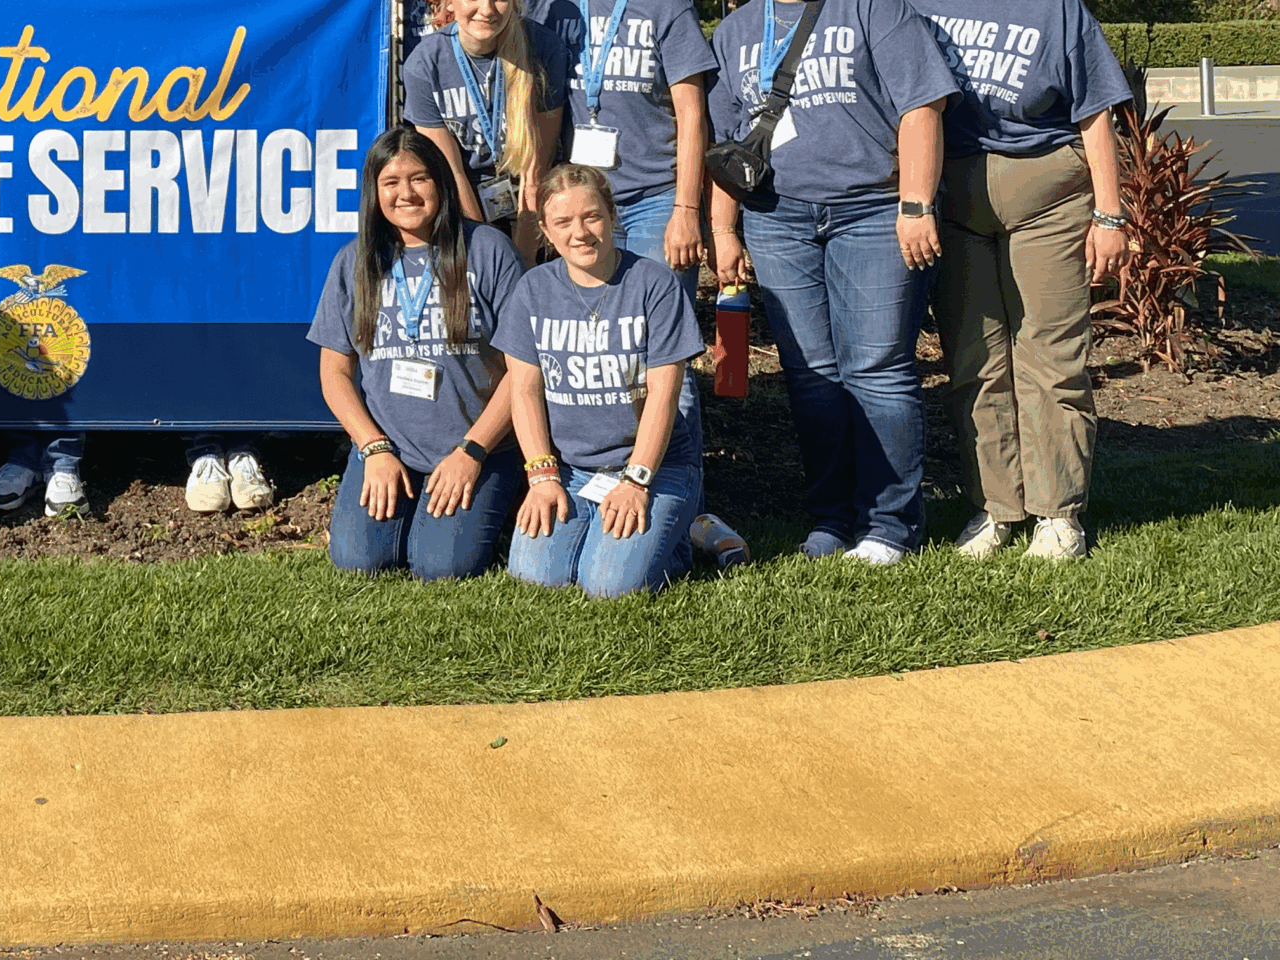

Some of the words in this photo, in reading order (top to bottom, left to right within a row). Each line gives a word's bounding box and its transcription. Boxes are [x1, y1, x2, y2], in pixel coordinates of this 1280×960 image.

[627, 19, 655, 49] TO
[824, 26, 855, 54] TO
[923, 14, 999, 48] IVING
[1004, 23, 1041, 56] TO
[575, 47, 656, 78] RVE
[789, 56, 858, 95] ERVE
[945, 45, 1031, 90] SERVE
[603, 80, 615, 91] OF
[978, 82, 1019, 105] SERVICE
[28, 128, 359, 234] SERVICE
[18, 322, 58, 338] FFA
[397, 306, 481, 342] SERE
[530, 315, 610, 353] LIVING
[432, 343, 445, 356] OF
[7, 354, 70, 385] EDUCATION
[577, 393, 603, 406] DAYS
[604, 392, 618, 405] OF
